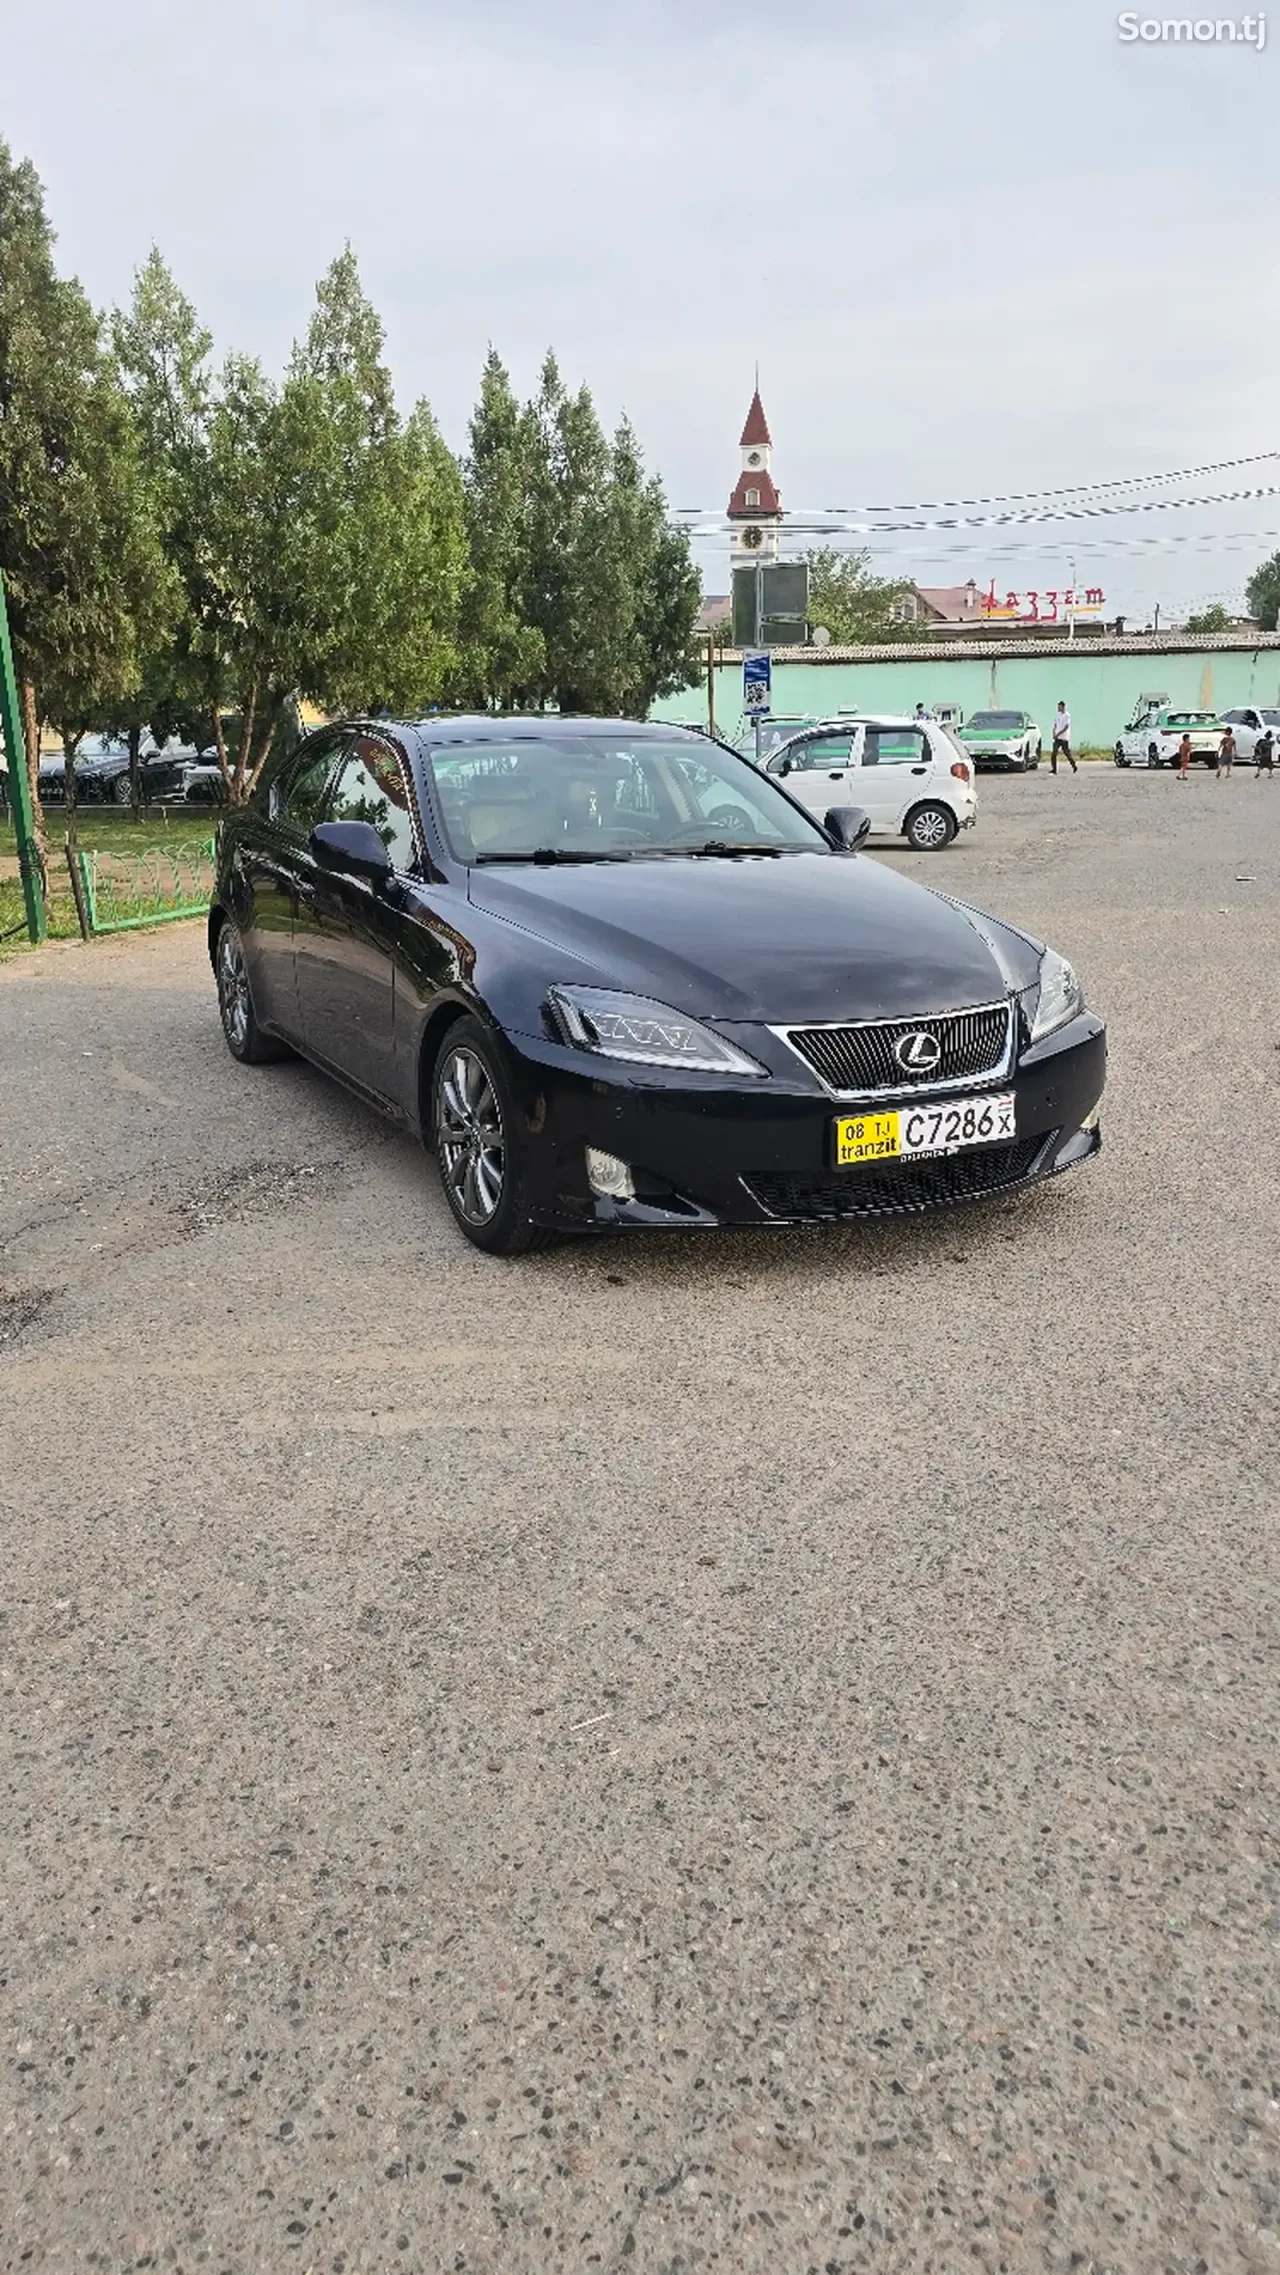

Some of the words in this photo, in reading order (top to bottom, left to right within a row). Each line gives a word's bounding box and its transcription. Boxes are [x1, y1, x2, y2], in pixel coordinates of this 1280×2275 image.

[845, 1123, 865, 1140] 08
[875, 1121, 891, 1136] TJ
[906, 1105, 994, 1147] C7286
[841, 1137, 897, 1160] tranzit
